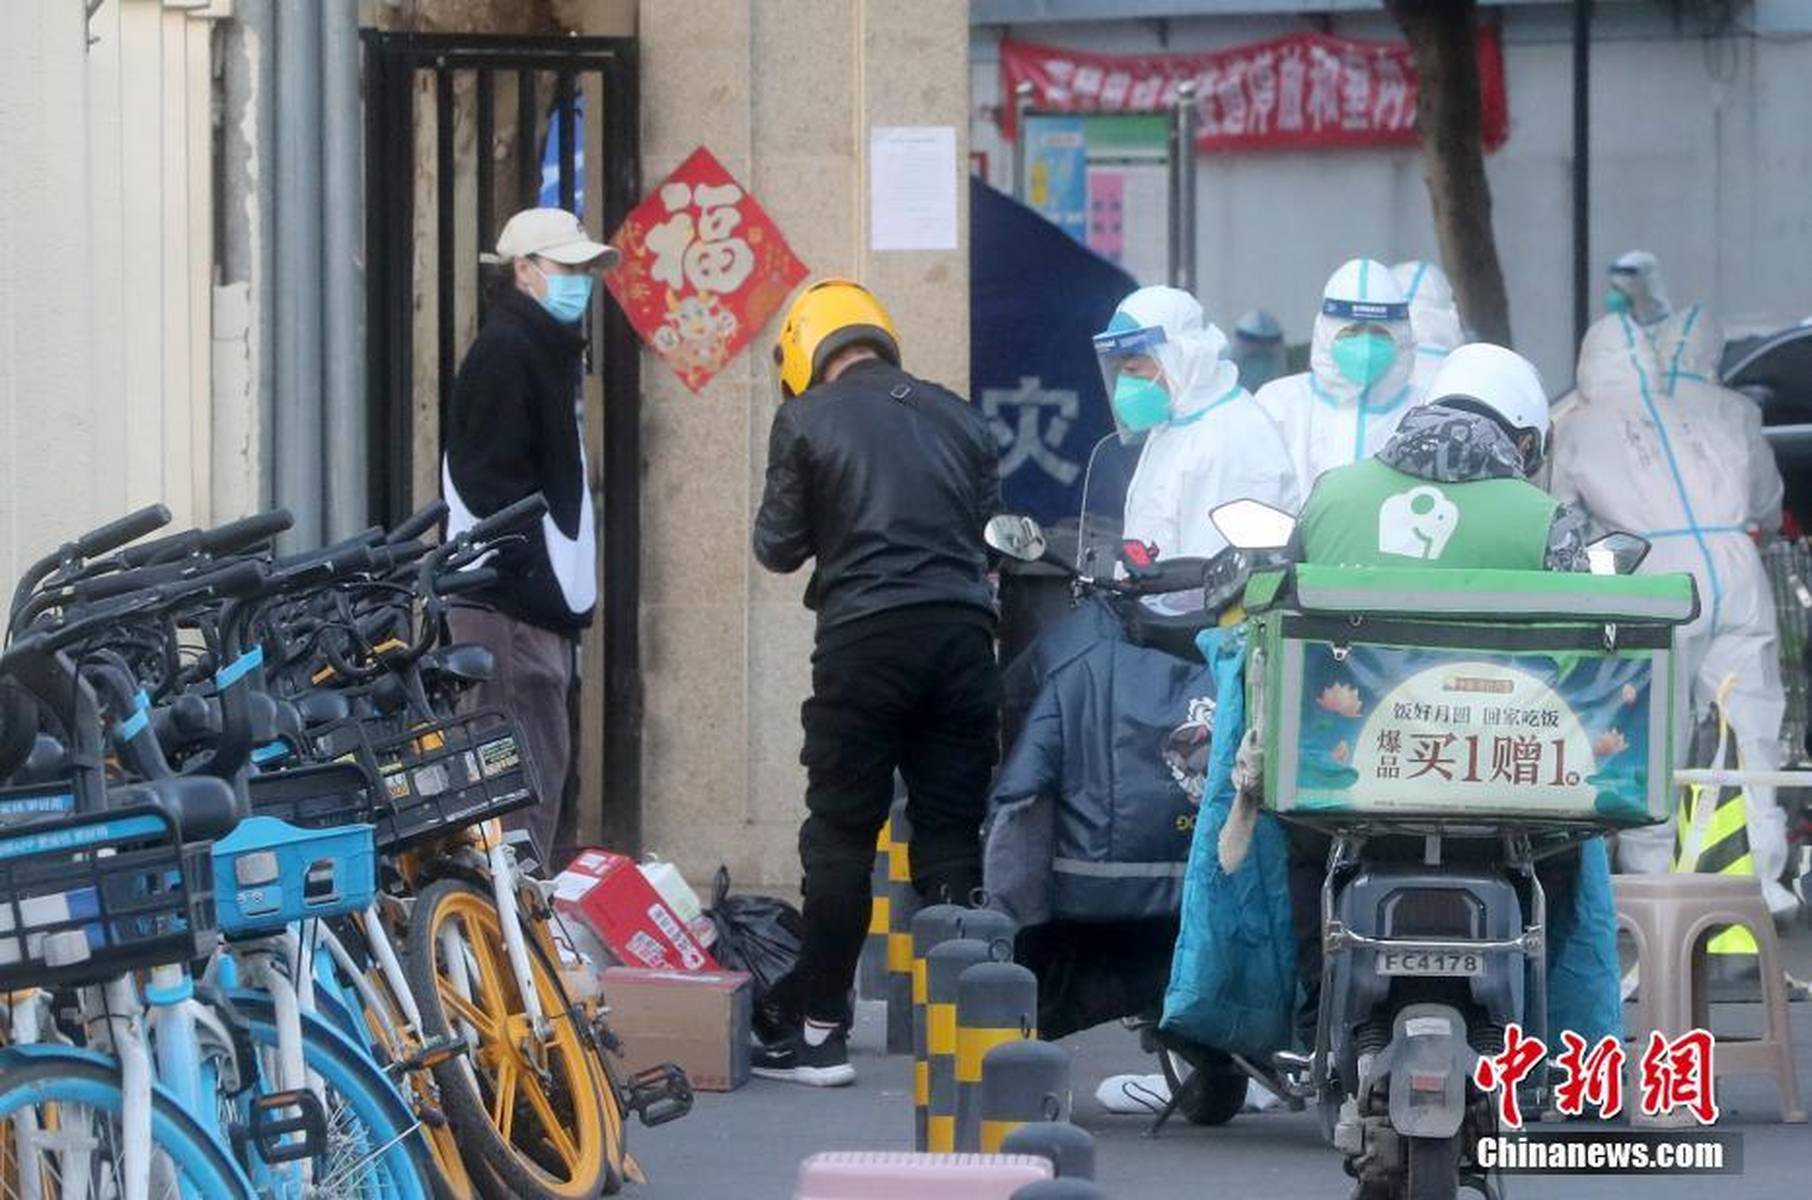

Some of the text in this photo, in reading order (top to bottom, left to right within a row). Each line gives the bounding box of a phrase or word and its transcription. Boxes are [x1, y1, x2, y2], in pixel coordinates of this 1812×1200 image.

[645, 182, 754, 293] 福
[982, 376, 1081, 485] 灾
[1483, 707, 1559, 728] 回家吃饭
[1376, 728, 1402, 779] 爆品
[1385, 954, 1478, 972] FC4178
